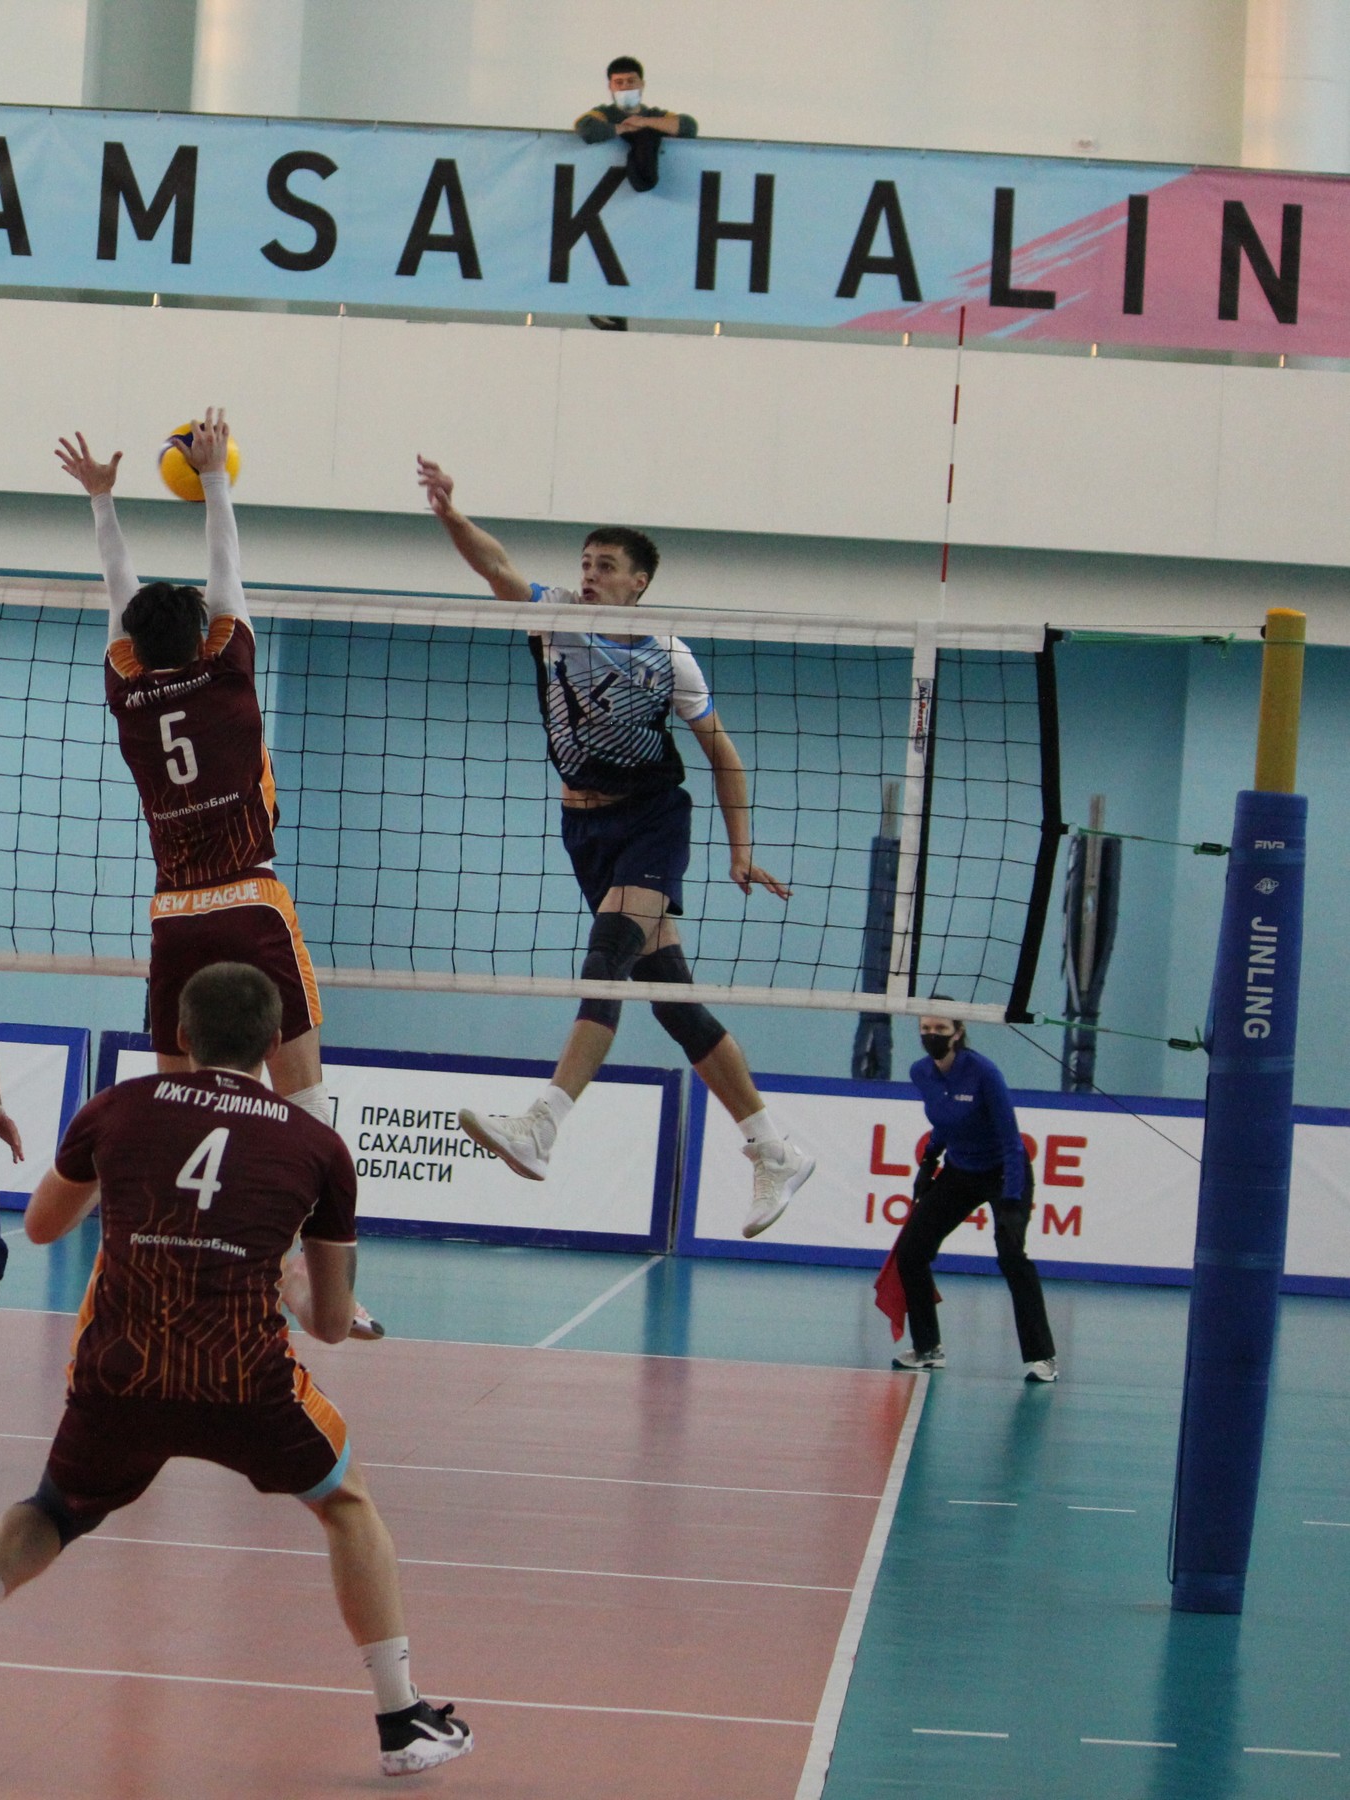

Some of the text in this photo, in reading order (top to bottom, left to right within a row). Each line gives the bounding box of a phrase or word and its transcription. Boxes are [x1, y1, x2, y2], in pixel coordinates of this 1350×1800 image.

[159, 710, 199, 785] 5
[192, 881, 260, 910] LEAGUE
[1243, 916, 1278, 1039] JINLING
[154, 1080, 289, 1123] ИЖГТУ-ДИНАМО
[361, 1106, 462, 1132] ПРАВИТЕ
[175, 1127, 230, 1211] 4
[356, 1158, 453, 1183] ОБЛАСТИ
